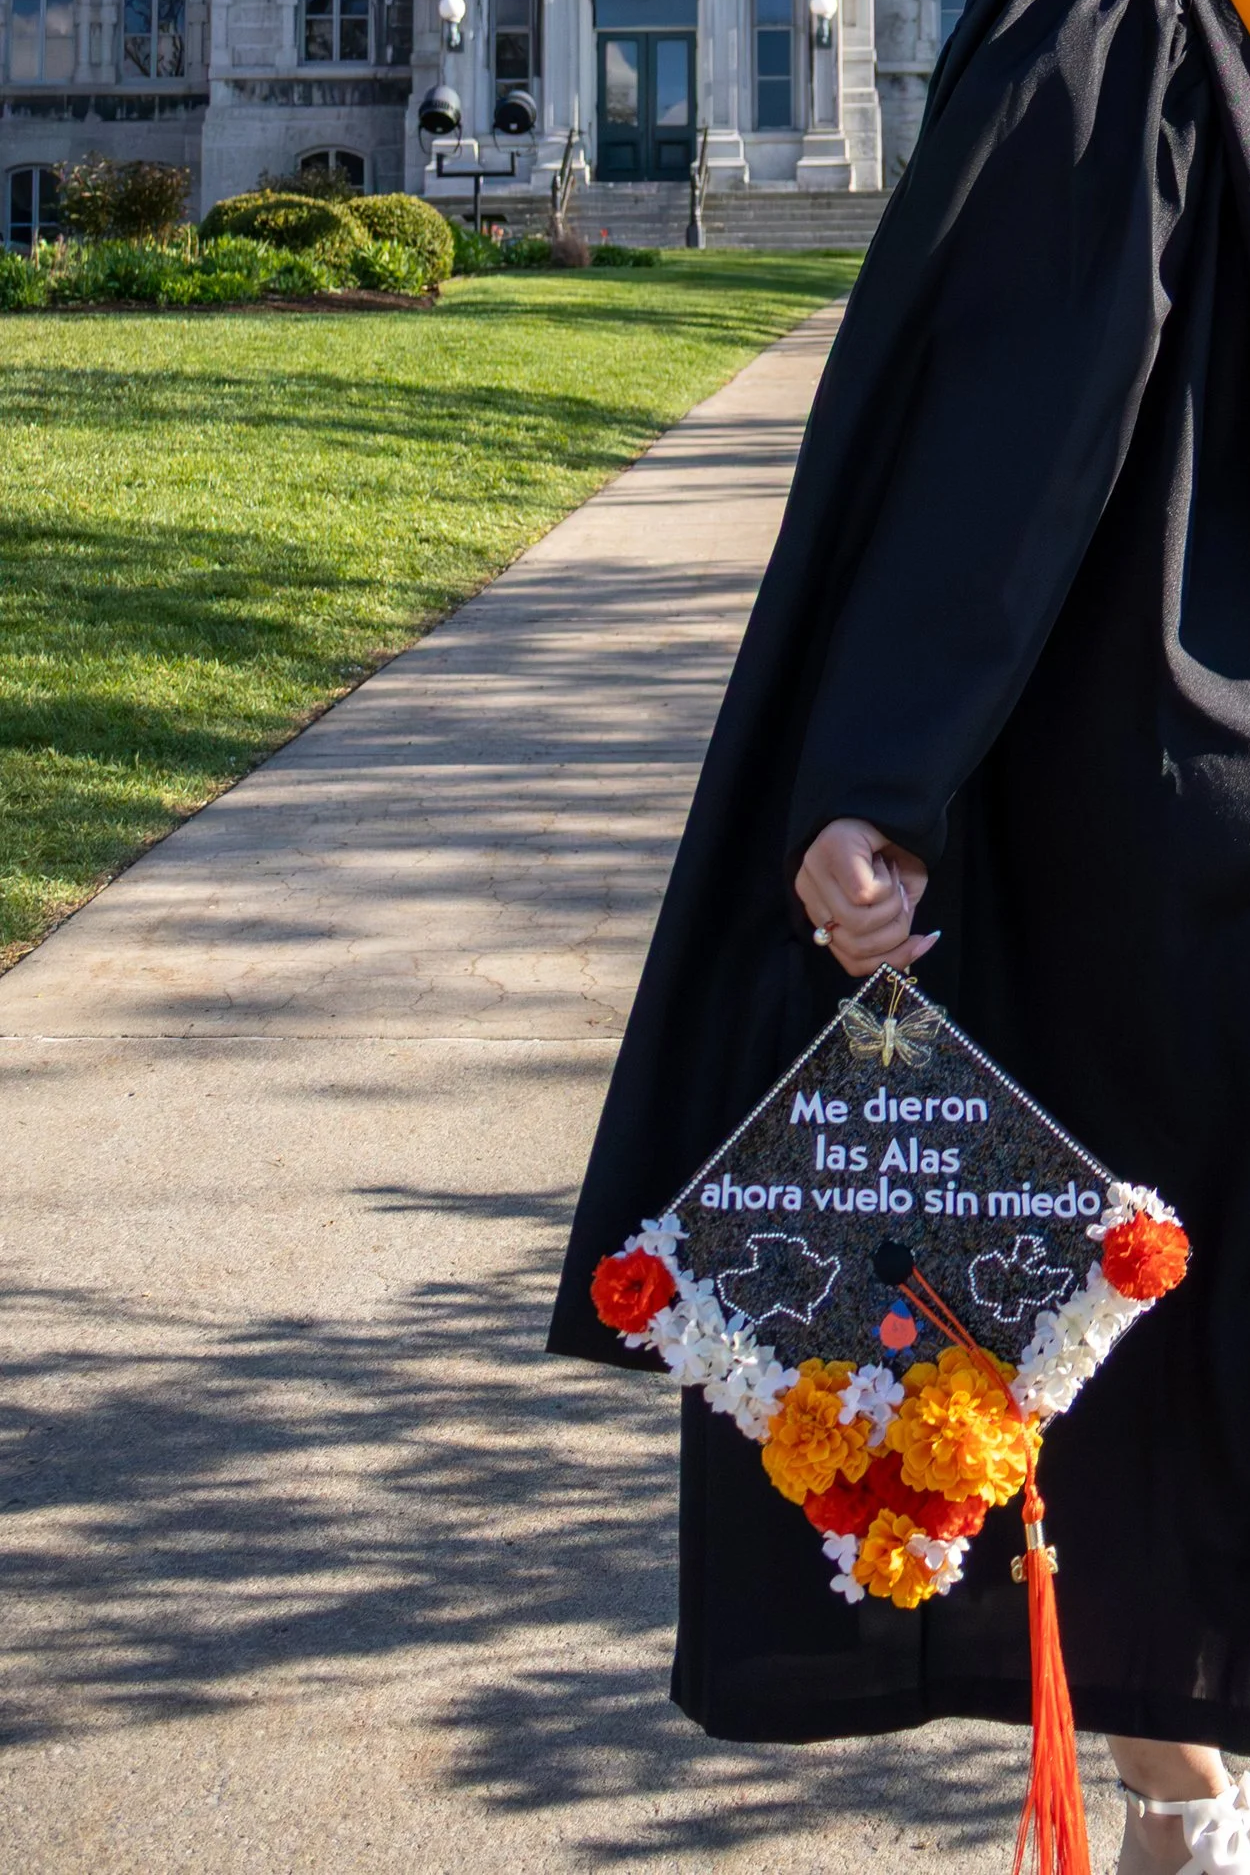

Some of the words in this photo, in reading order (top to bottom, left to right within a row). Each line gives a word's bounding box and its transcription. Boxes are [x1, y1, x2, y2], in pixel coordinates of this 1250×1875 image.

[789, 1090, 849, 1125] Me
[863, 1085, 988, 1124] dieron
[815, 1133, 869, 1172] las
[878, 1136, 961, 1174] Alas
[700, 1173, 803, 1212] ahora
[810, 1175, 914, 1215] vuelo
[923, 1181, 979, 1217] sin
[986, 1180, 1101, 1218] miedo
